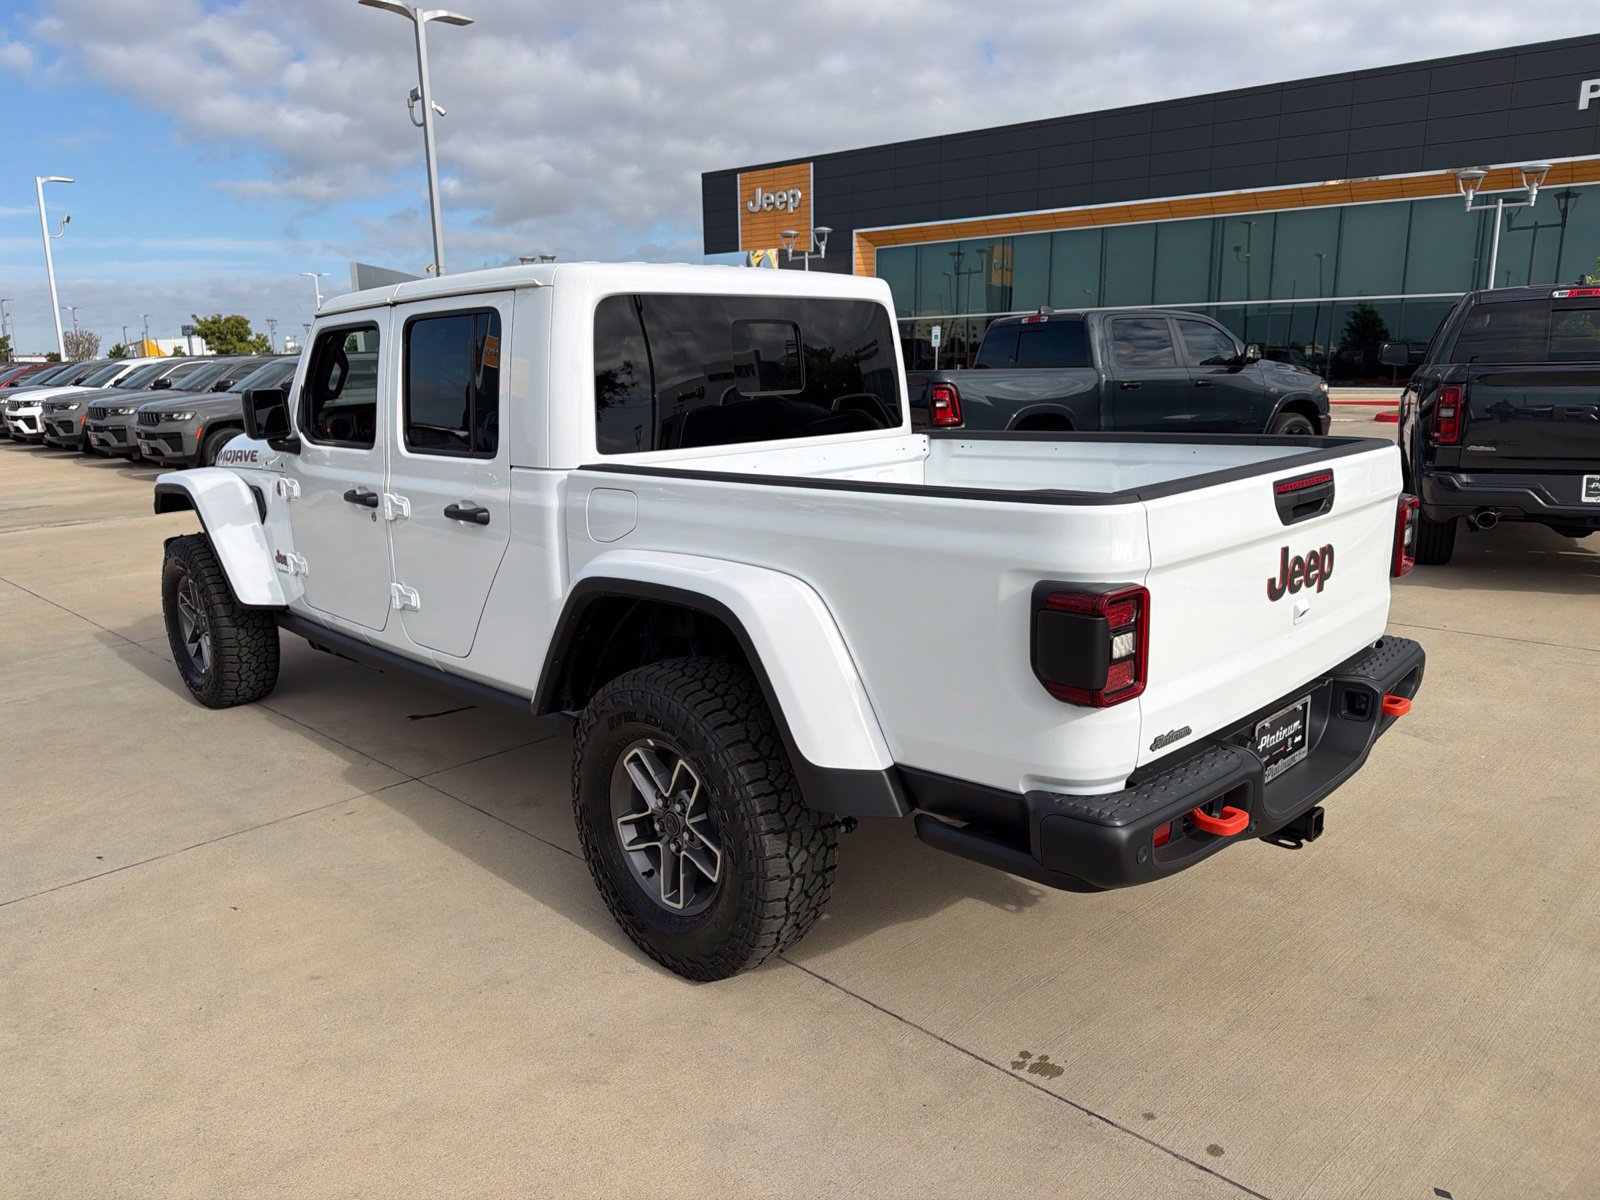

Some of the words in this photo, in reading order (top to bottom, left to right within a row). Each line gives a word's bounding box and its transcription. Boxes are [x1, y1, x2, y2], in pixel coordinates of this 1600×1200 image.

[747, 187, 802, 213] Jeep
[217, 449, 259, 464] MOJAVE
[1267, 543, 1334, 602] Jeep
[1257, 720, 1302, 752] Platinum
